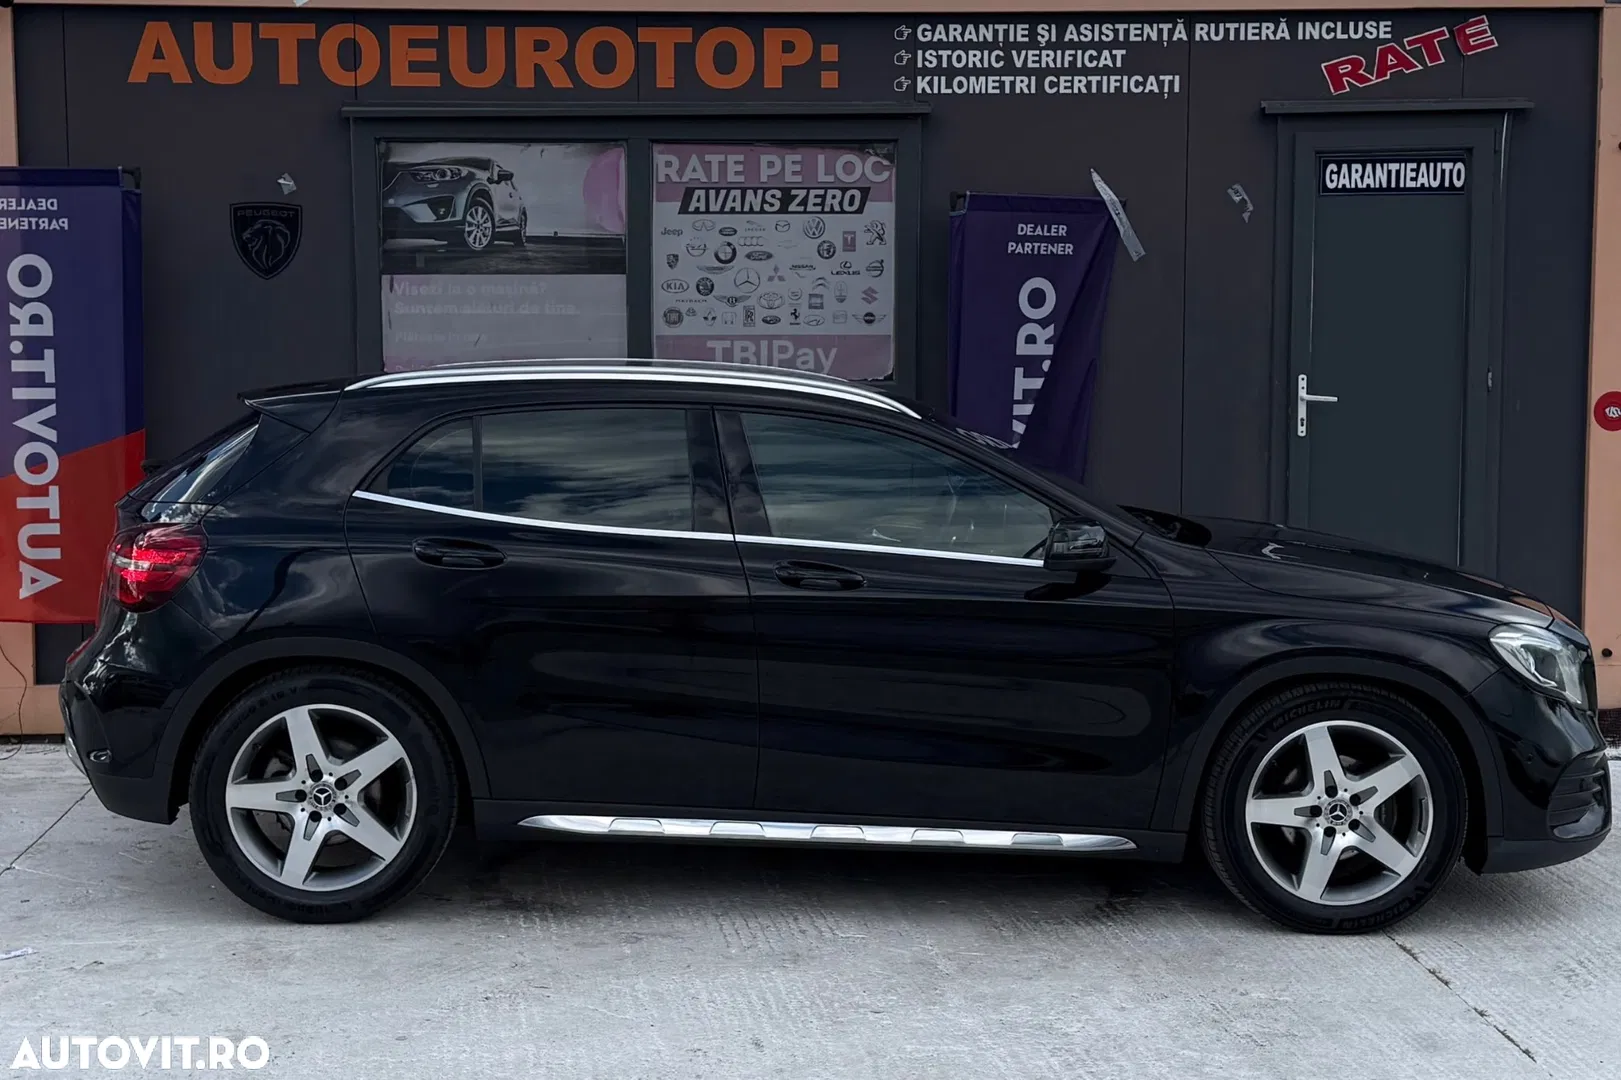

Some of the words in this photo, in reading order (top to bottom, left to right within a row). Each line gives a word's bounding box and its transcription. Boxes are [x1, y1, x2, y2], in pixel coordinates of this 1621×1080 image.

[916, 24, 1029, 47] GARANȚIE
[1194, 17, 1291, 42] RUTIERĂ
[1297, 20, 1393, 40] INCLUSE
[127, 21, 839, 90] AUTOEUROTOP:
[916, 49, 1005, 68] ISTORIC
[1011, 49, 1127, 68] VERIFICAT
[1320, 14, 1499, 96] RATE
[916, 75, 1036, 94] KILOMETRI
[1043, 75, 1181, 99] CERTIFICAȚI
[656, 153, 745, 183] RATE
[759, 154, 803, 183] PE
[817, 154, 892, 183] LOC
[1324, 161, 1466, 190] GARANTIEAUTO
[237, 208, 296, 218] PEUGEOT
[688, 189, 782, 213] AVANS
[787, 189, 862, 213] ZERO
[660, 226, 684, 237] Jeep
[1017, 223, 1068, 237] DEALER
[1007, 241, 1074, 256] PARTENER
[666, 281, 685, 291] KIA
[706, 339, 838, 374] TBIPay
